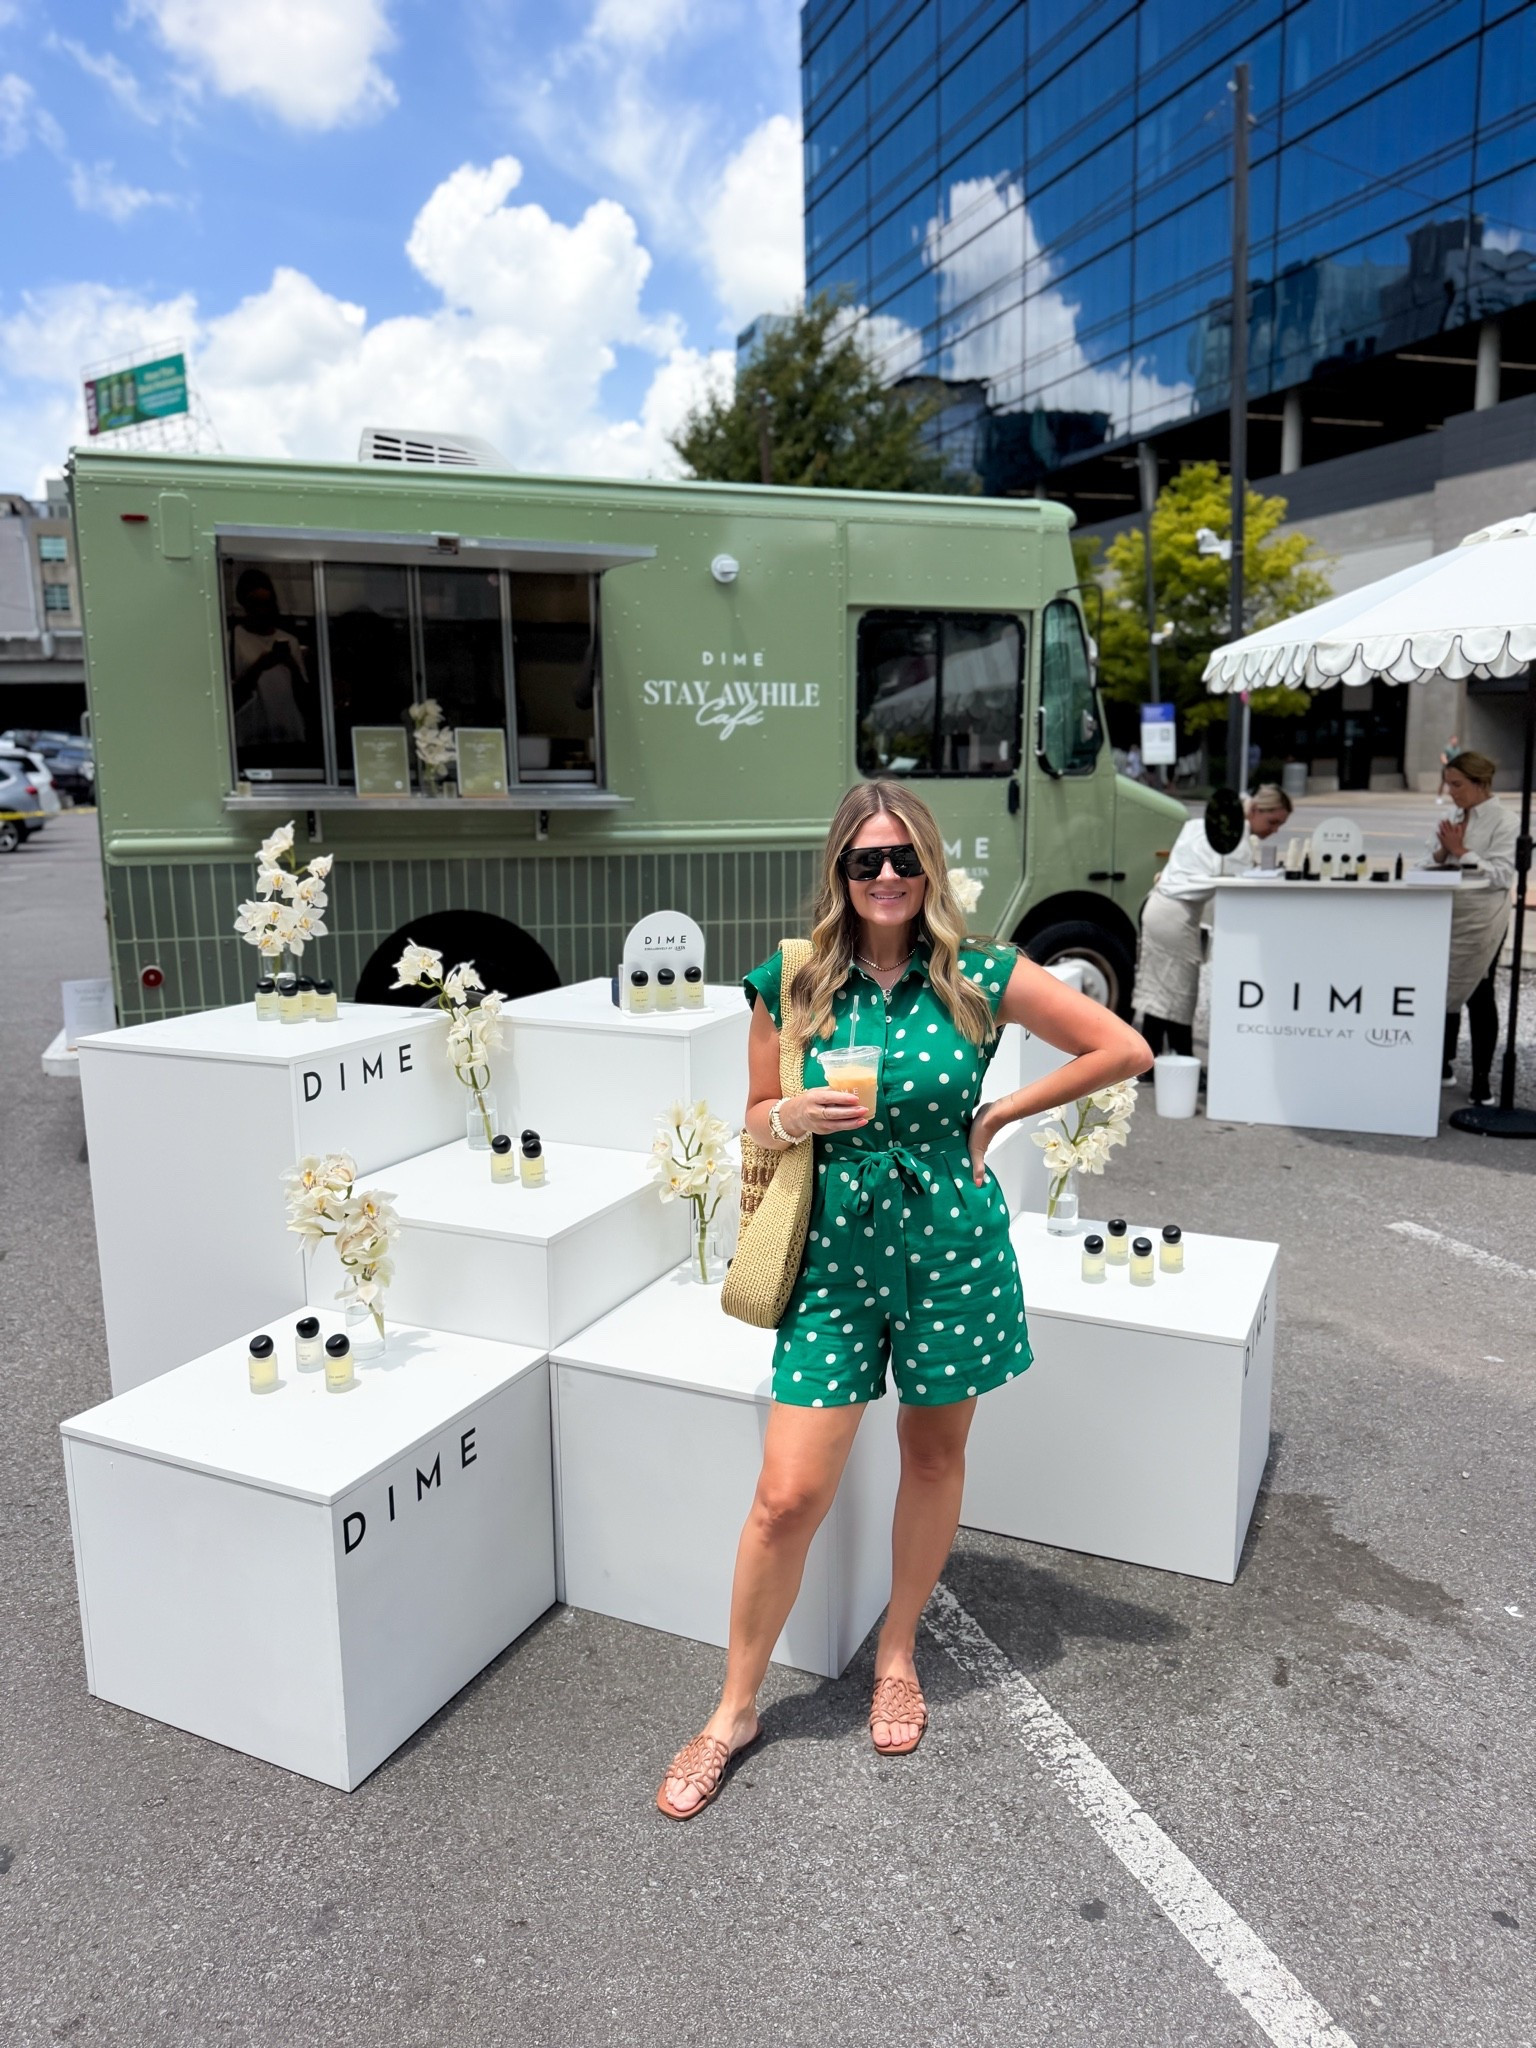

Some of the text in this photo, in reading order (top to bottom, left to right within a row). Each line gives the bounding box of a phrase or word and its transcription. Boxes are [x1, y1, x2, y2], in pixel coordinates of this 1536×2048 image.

[702, 651, 763, 667] DIME
[643, 680, 820, 707] STAY AWHILE
[644, 935, 687, 945] DIME
[1238, 980, 1416, 1017] DIME
[1236, 1023, 1413, 1043] EXCLUSIVELY AT ULTA
[303, 1043, 413, 1102] DIME
[1244, 1292, 1268, 1380] DIME
[343, 1426, 478, 1556] DIME
